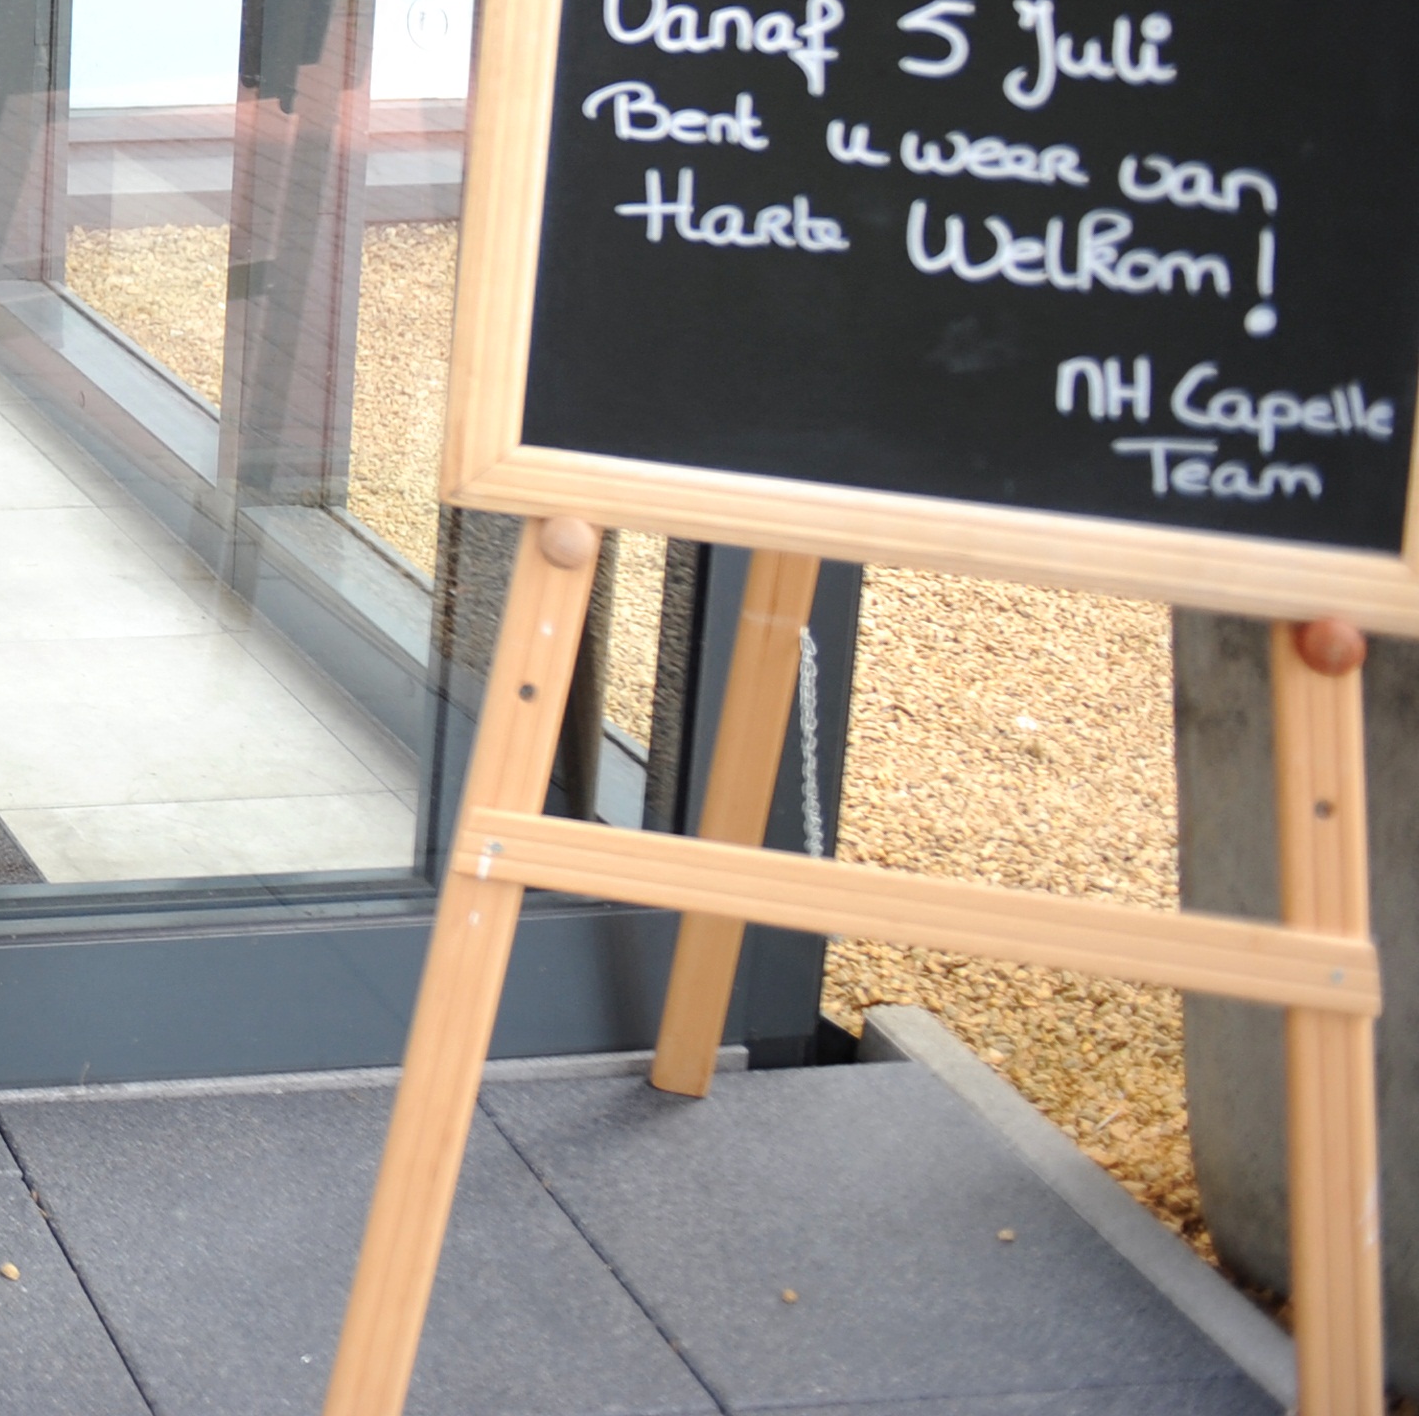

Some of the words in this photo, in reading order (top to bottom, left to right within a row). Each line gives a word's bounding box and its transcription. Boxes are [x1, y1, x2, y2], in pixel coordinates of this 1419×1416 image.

[582, 80, 769, 151] Bent
[826, 118, 890, 167] u
[1170, 360, 1395, 454] Capelle
[1112, 436, 1322, 499] Team
